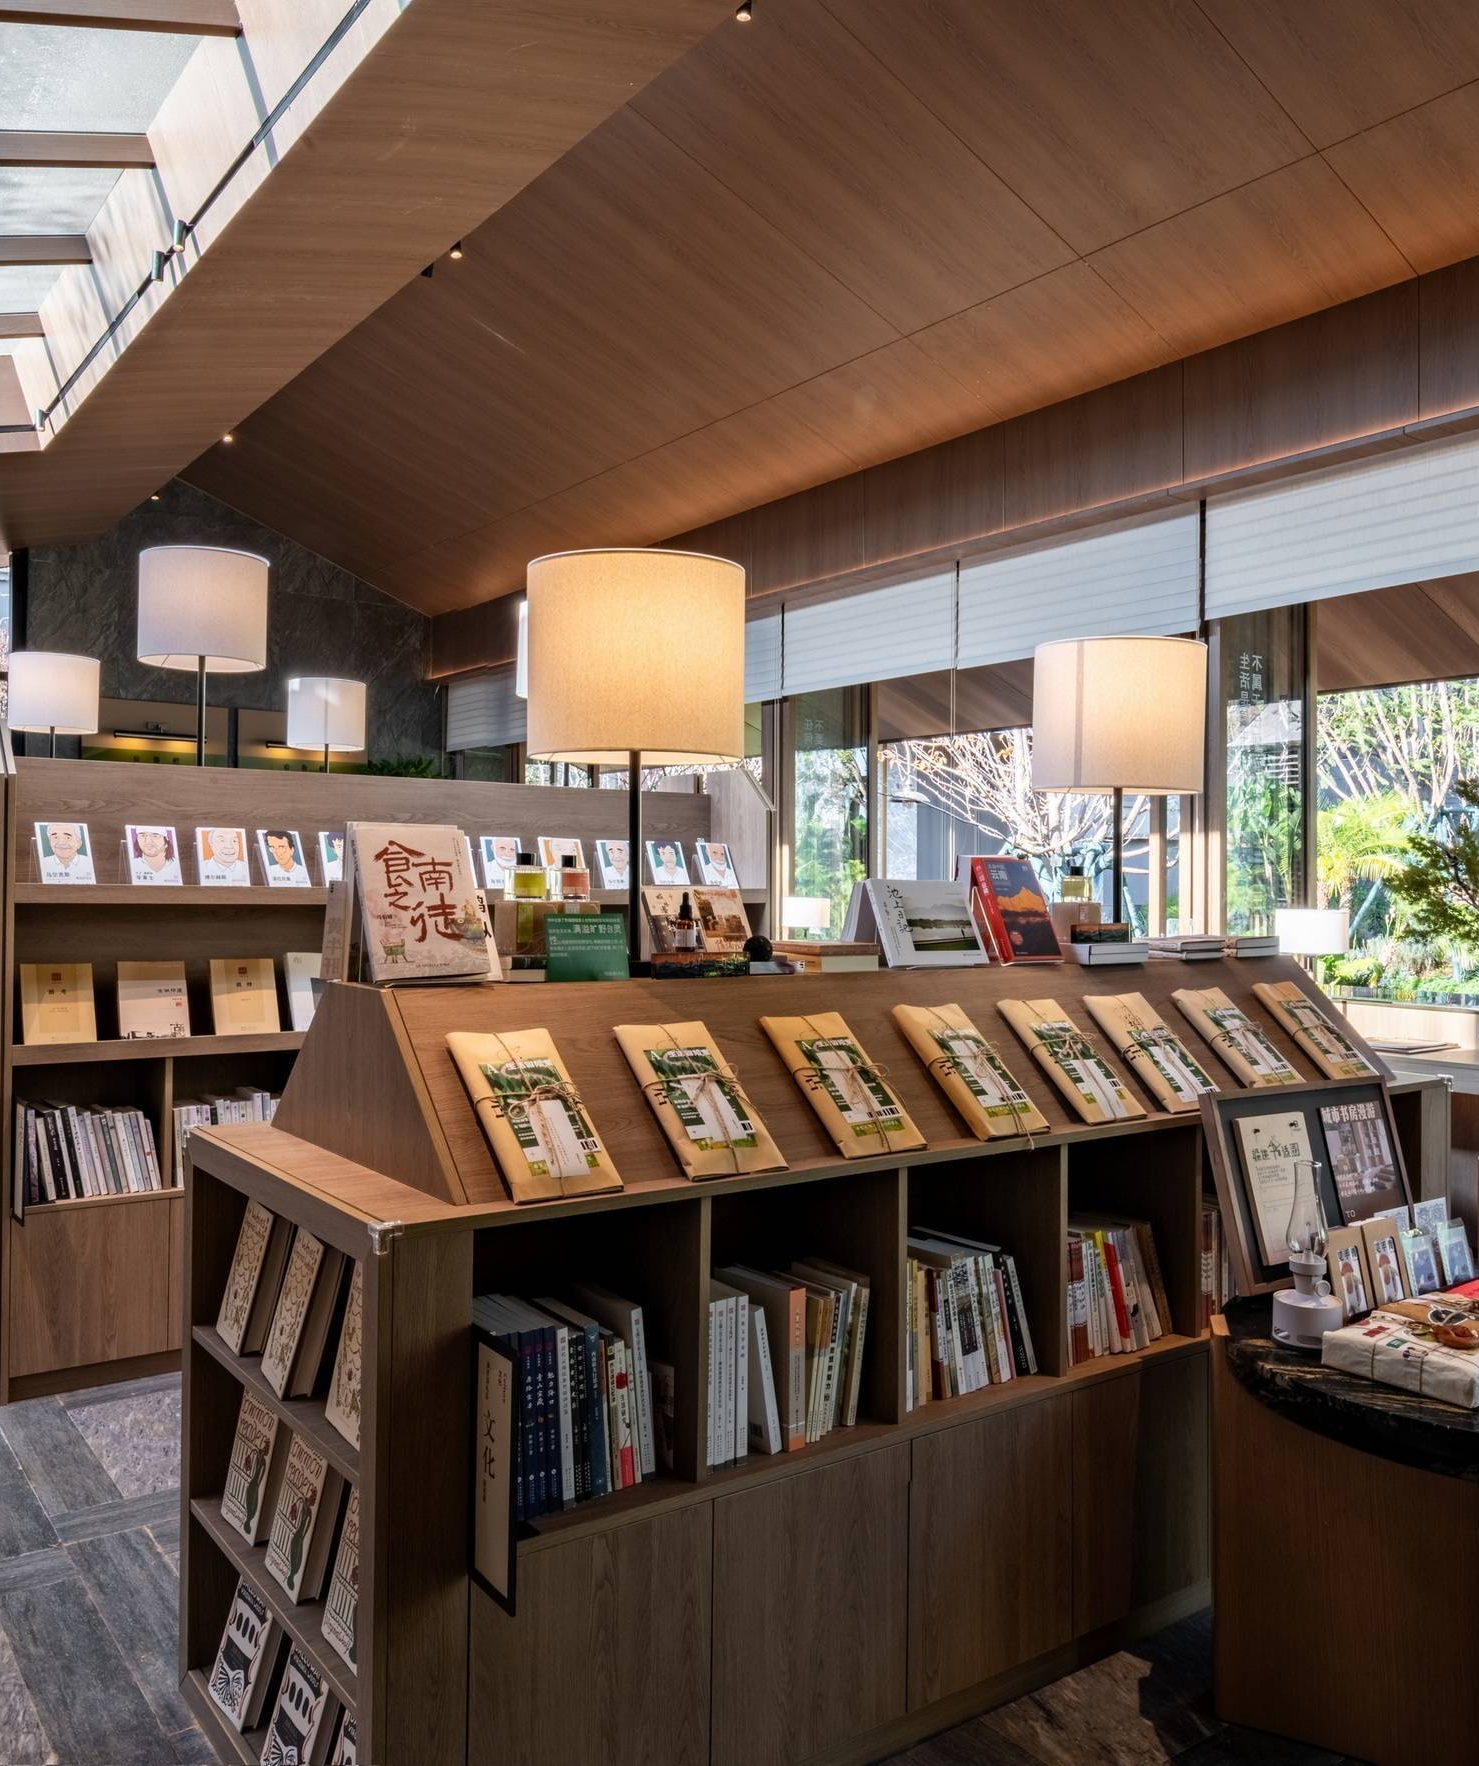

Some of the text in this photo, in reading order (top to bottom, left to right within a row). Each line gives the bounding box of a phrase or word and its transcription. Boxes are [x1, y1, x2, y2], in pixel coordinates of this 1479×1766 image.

[1322, 1103, 1376, 1124] 城市书房漫游
[1345, 1210, 1356, 1218] TO
[483, 1409, 496, 1480] 文化
